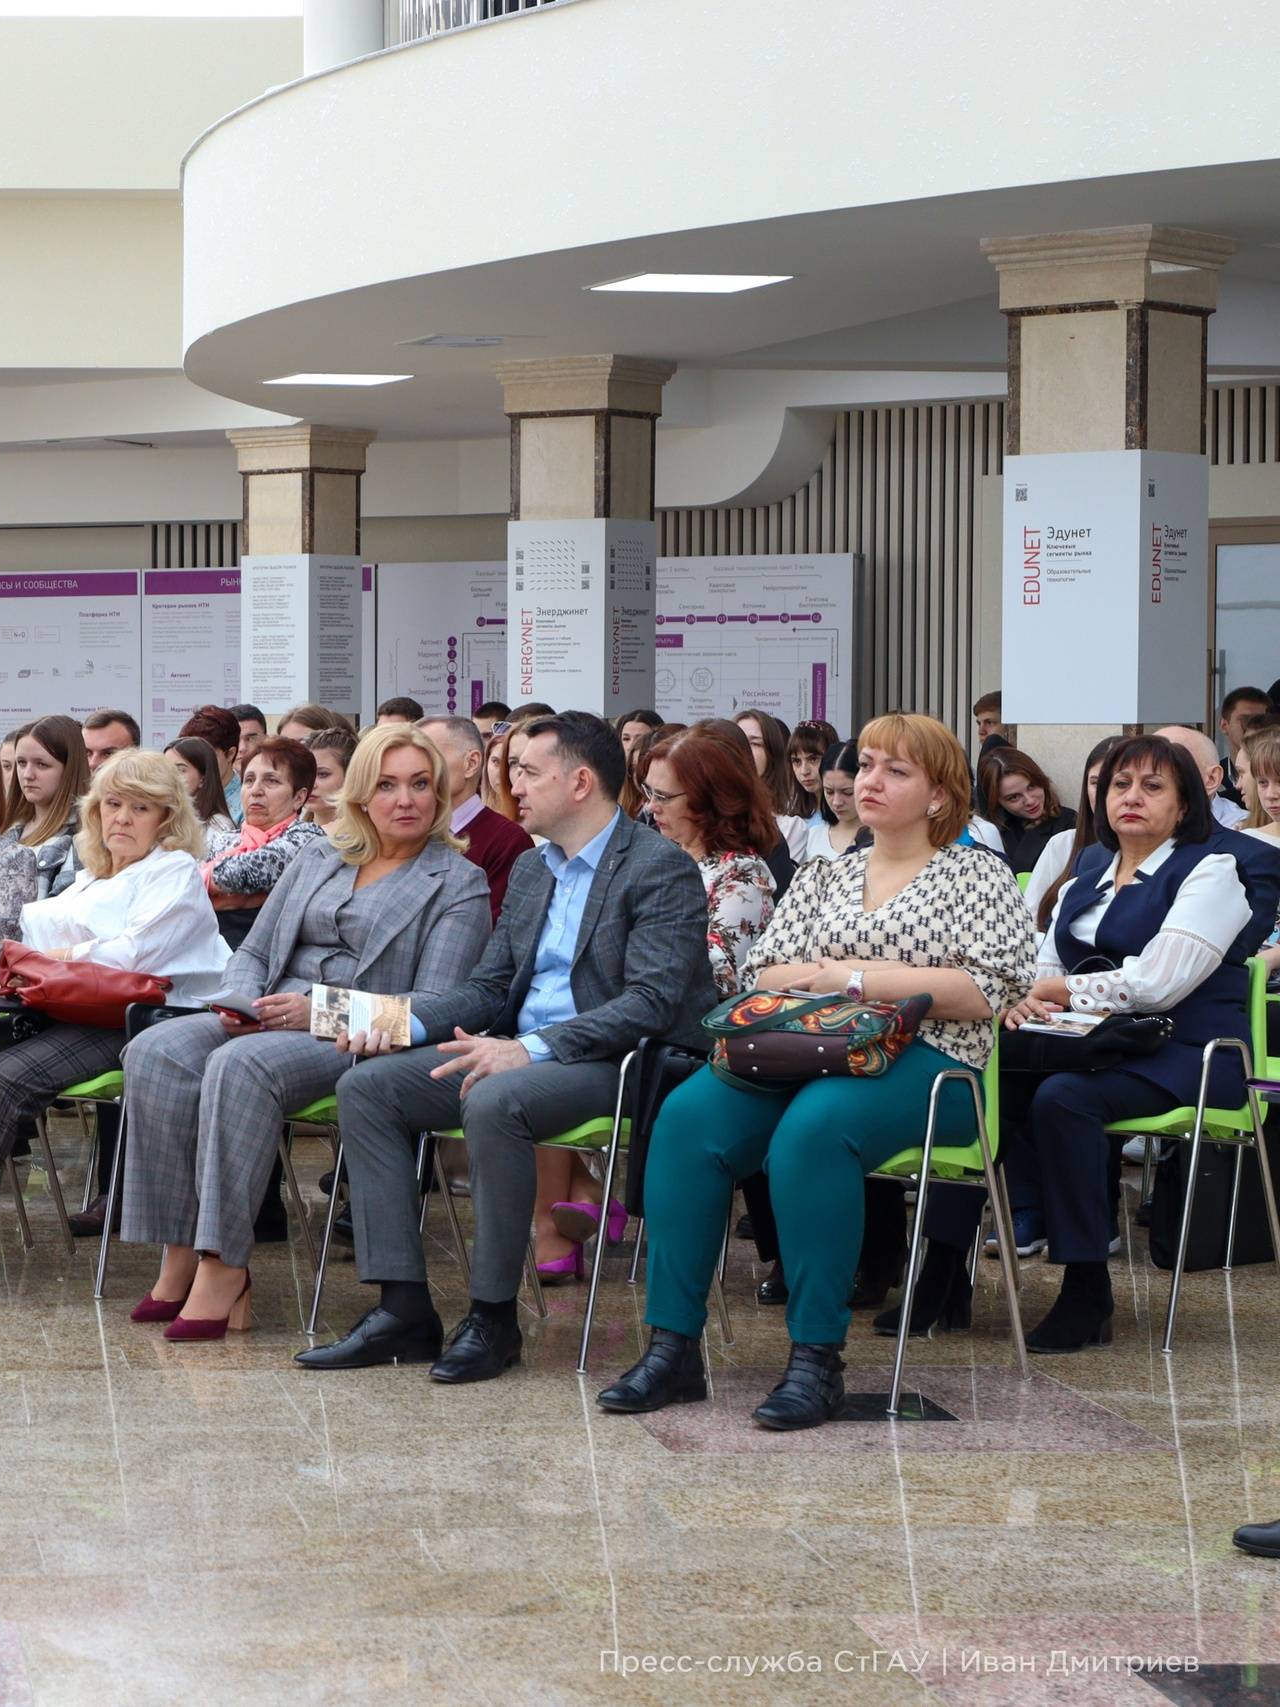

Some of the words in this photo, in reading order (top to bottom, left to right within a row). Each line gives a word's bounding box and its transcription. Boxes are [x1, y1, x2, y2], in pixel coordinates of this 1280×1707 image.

[1047, 526, 1092, 541] Эдунет
[1164, 525, 1188, 540] Эдунет
[15, 580, 21, 590] И
[23, 579, 78, 590] СООБЩЕСТВА
[1023, 526, 1041, 606] EDUNET
[1152, 522, 1161, 603] EDUNET
[536, 606, 589, 617] Энерджинет
[521, 608, 533, 695] ENERGYNET
[612, 606, 620, 695] ENERGYNET
